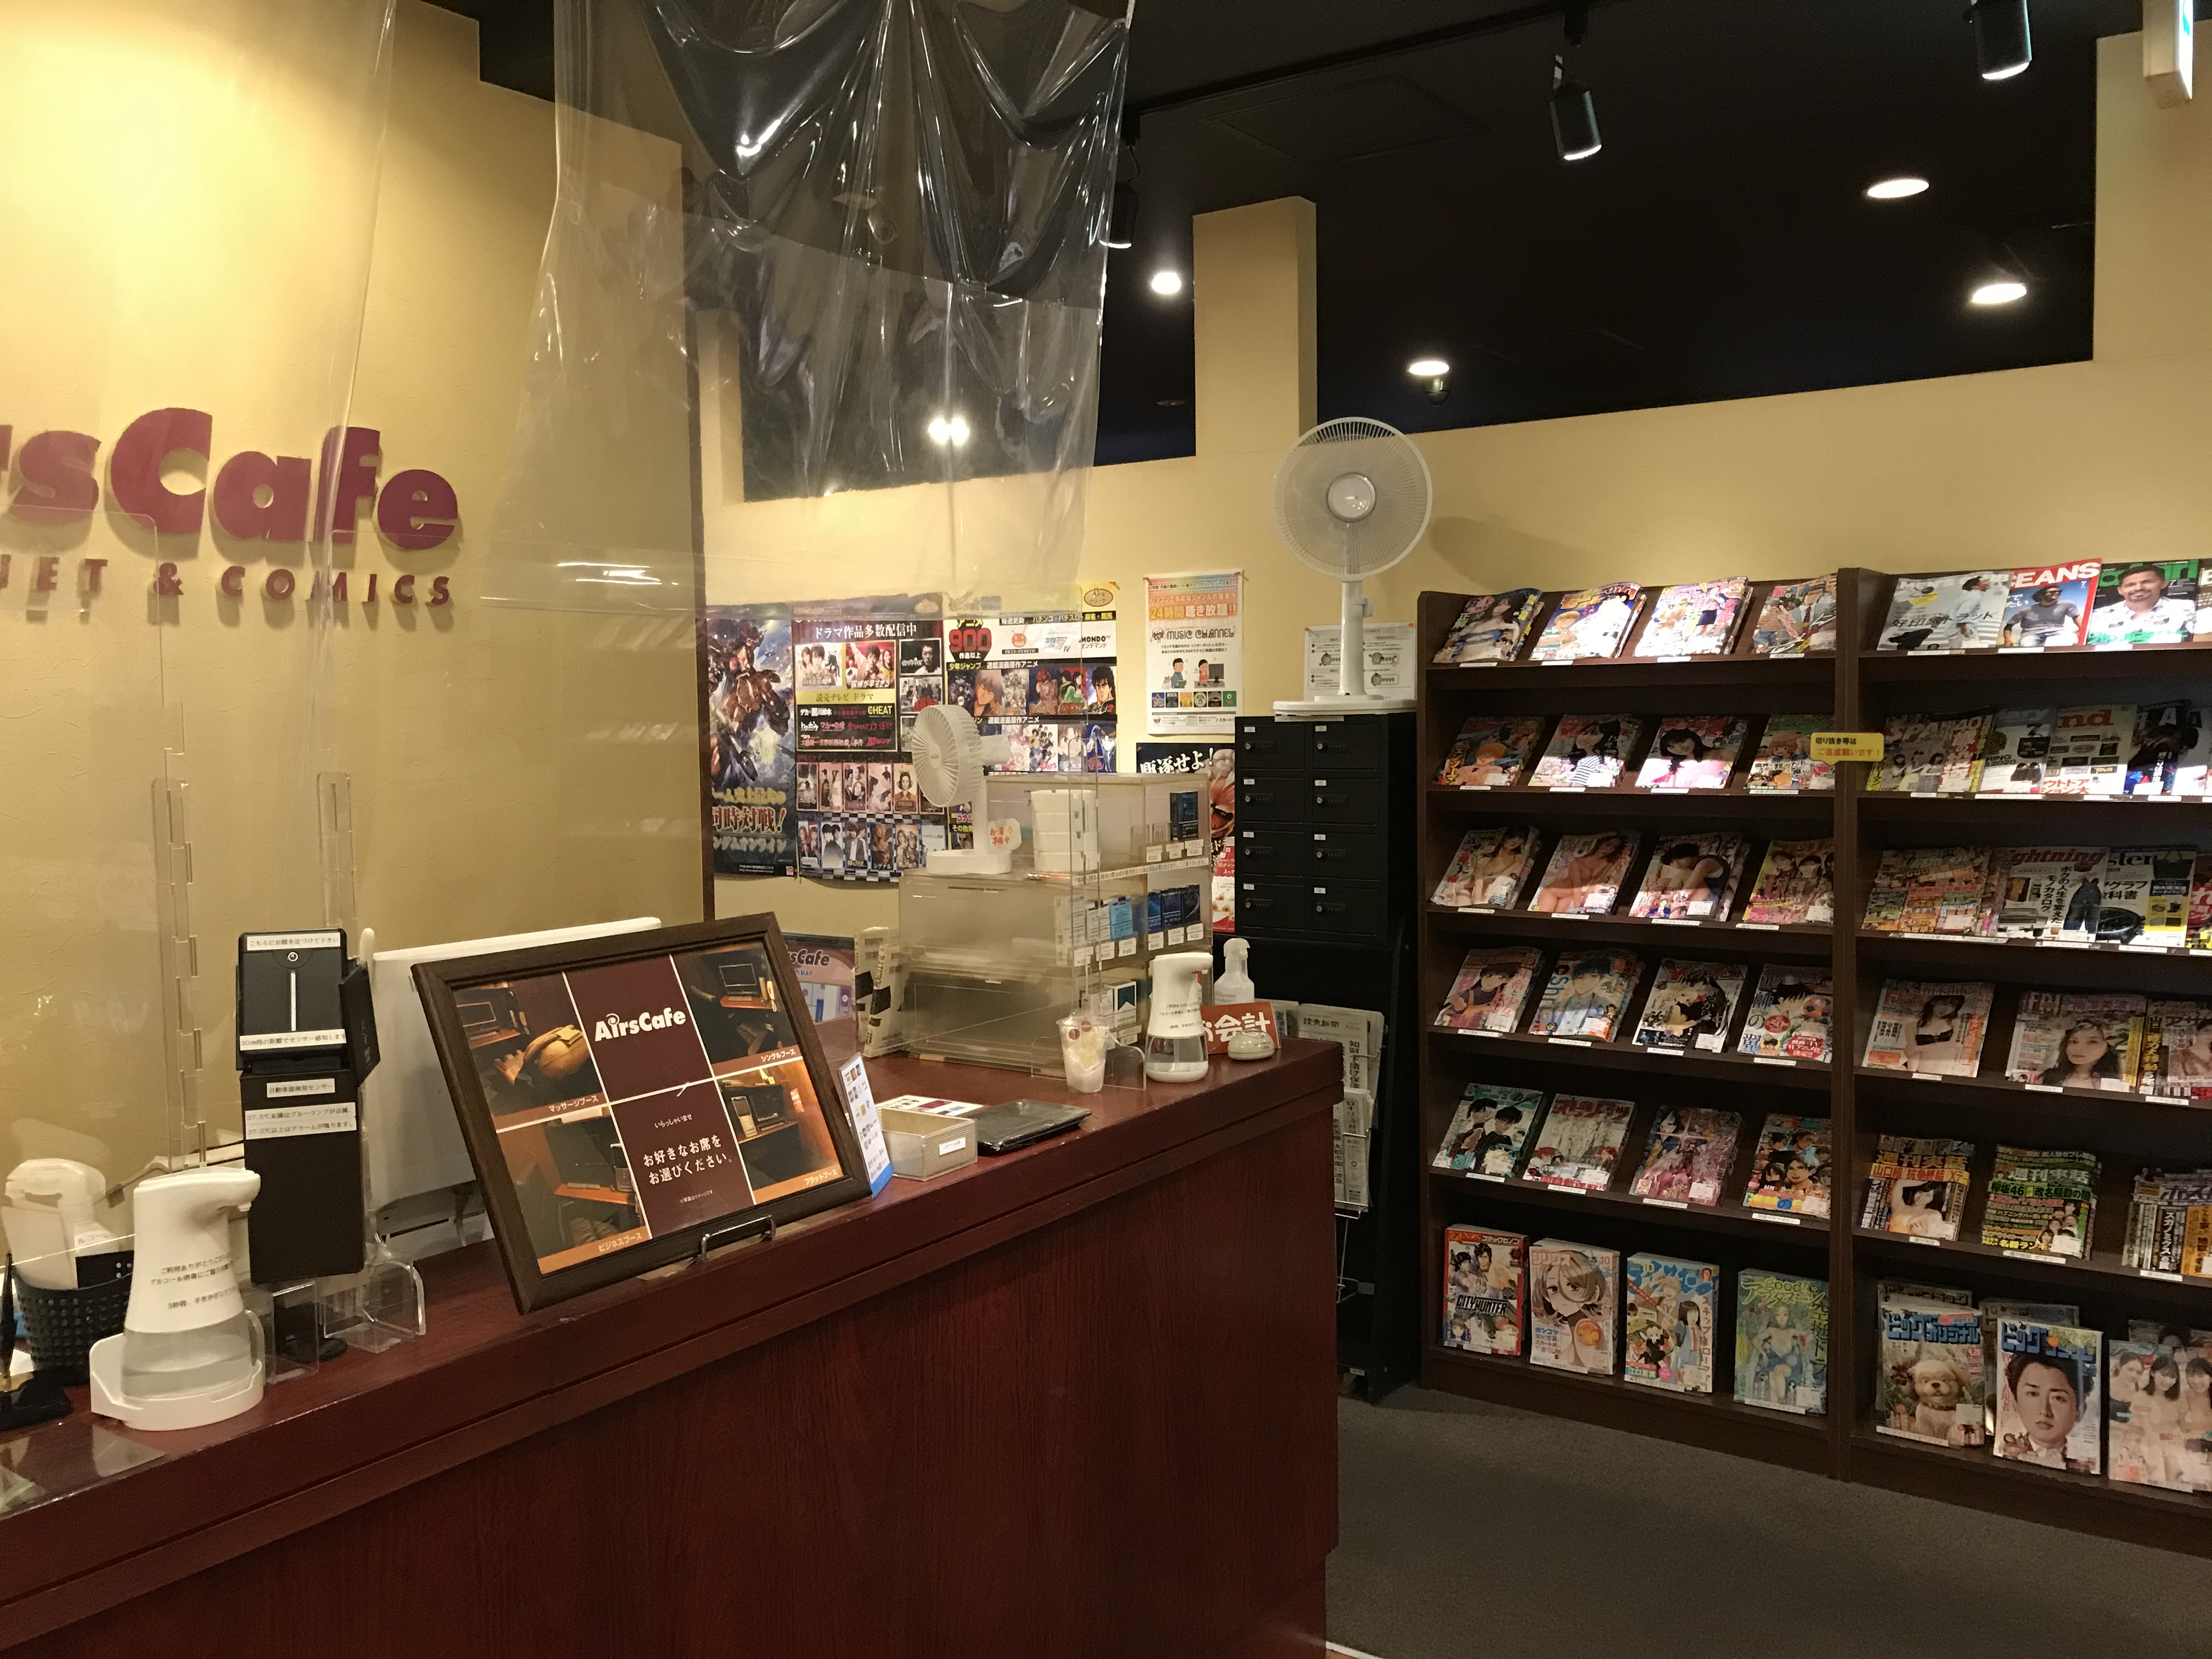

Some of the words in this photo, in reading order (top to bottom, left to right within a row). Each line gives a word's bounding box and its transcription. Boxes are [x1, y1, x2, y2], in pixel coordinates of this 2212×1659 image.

[0, 408, 459, 550] sCafe
[0, 555, 108, 591] ET
[157, 562, 184, 596] &
[221, 566, 451, 606] COMICS
[815, 623, 918, 640] ドラマ作品多数配信中
[949, 627, 992, 653] 900
[1166, 630, 1193, 640] MUSIC
[1195, 628, 1234, 640] CHANNEL
[853, 693, 874, 701] ドラマ
[867, 706, 893, 715] CHEAT
[594, 1007, 686, 1042] AirsCafe
[760, 1048, 797, 1063] シングルブース
[548, 1094, 599, 1113] マッサージブース
[654, 1113, 693, 1128] いらっしゃいませ
[643, 1134, 722, 1167] お好きなお席を
[648, 1153, 733, 1186] お選びください。
[804, 1167, 839, 1186] フラットブース
[597, 1231, 642, 1252] ビジネスブース
